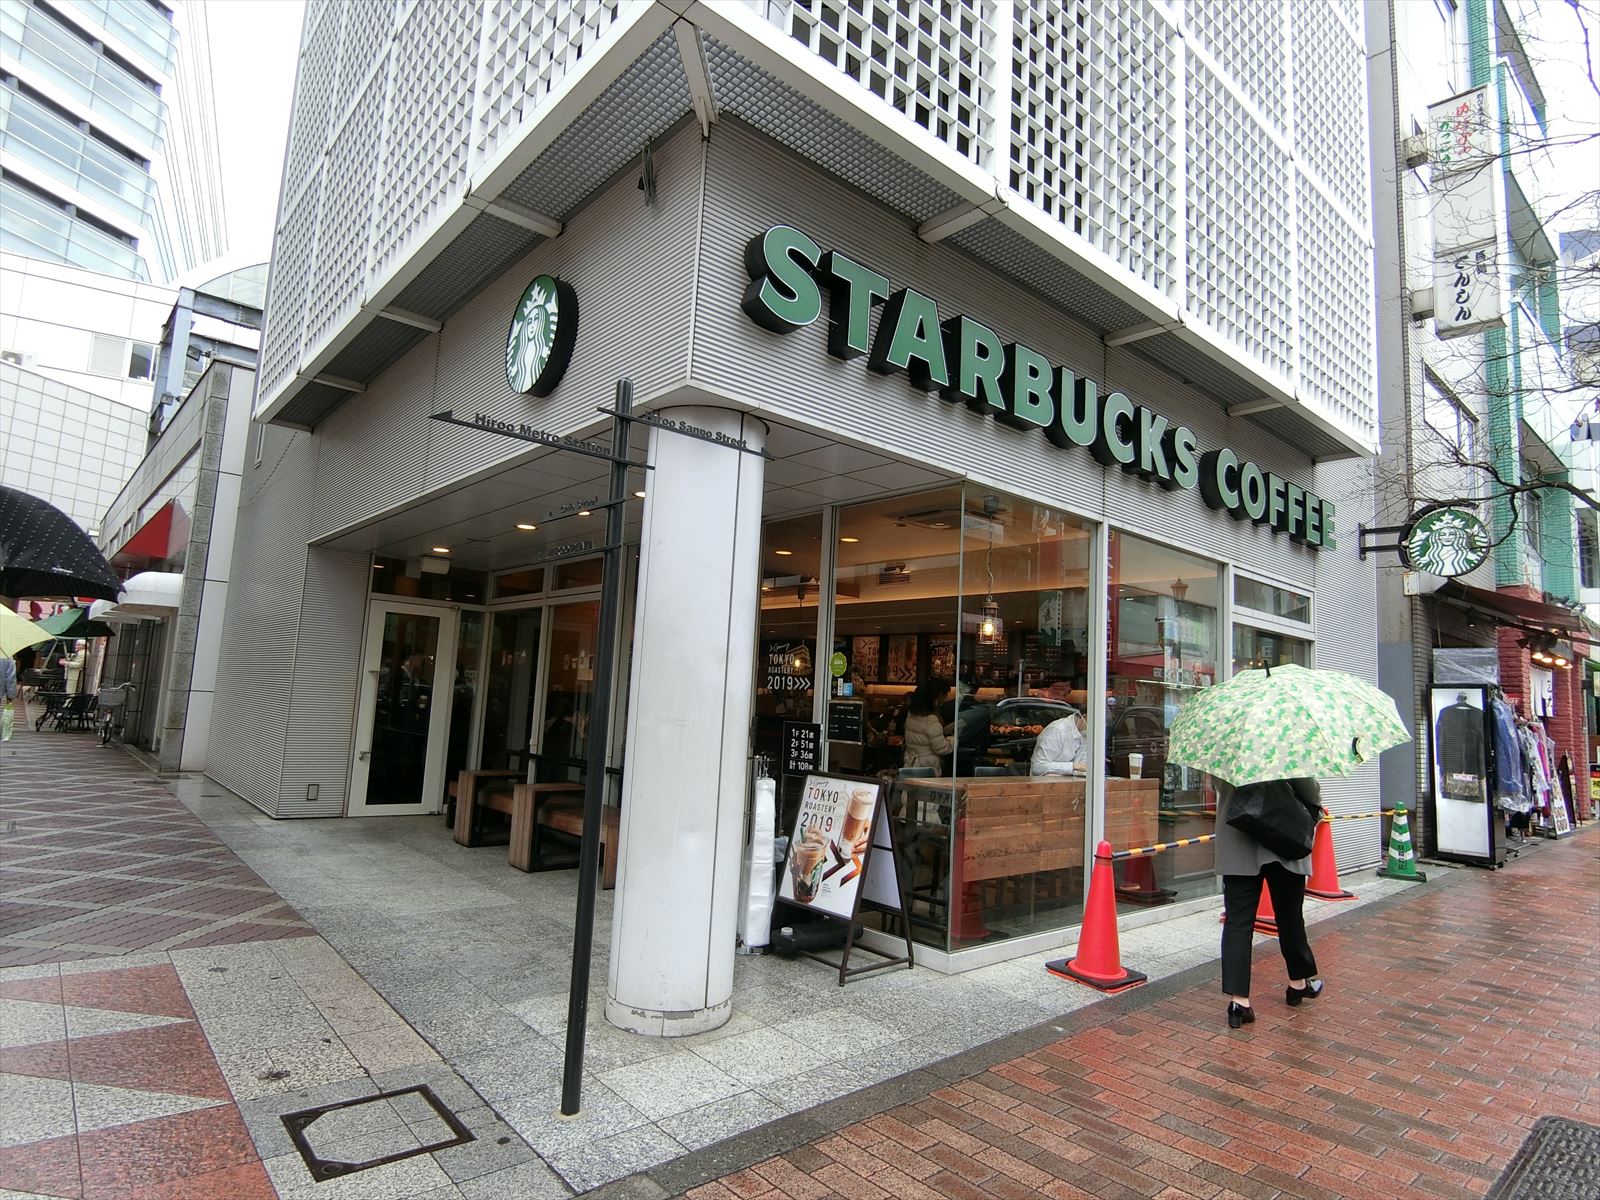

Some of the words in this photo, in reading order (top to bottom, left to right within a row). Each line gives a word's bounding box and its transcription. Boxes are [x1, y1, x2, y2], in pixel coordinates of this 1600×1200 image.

[744, 224, 1200, 491] STARBUCKS
[1212, 448, 1337, 552] COFFEE
[474, 412, 515, 432] Hiroo
[519, 422, 561, 443] Metro
[564, 435, 611, 456] Station
[715, 431, 748, 449] Street
[768, 653, 795, 665] TOKYO
[767, 675, 794, 690] 2019
[791, 728, 800, 738] 1F
[790, 738, 799, 748] 2F
[790, 748, 799, 758] 3F
[807, 786, 839, 804] TOKYO
[804, 801, 836, 813] ROASTERY
[800, 811, 833, 833] 2019
